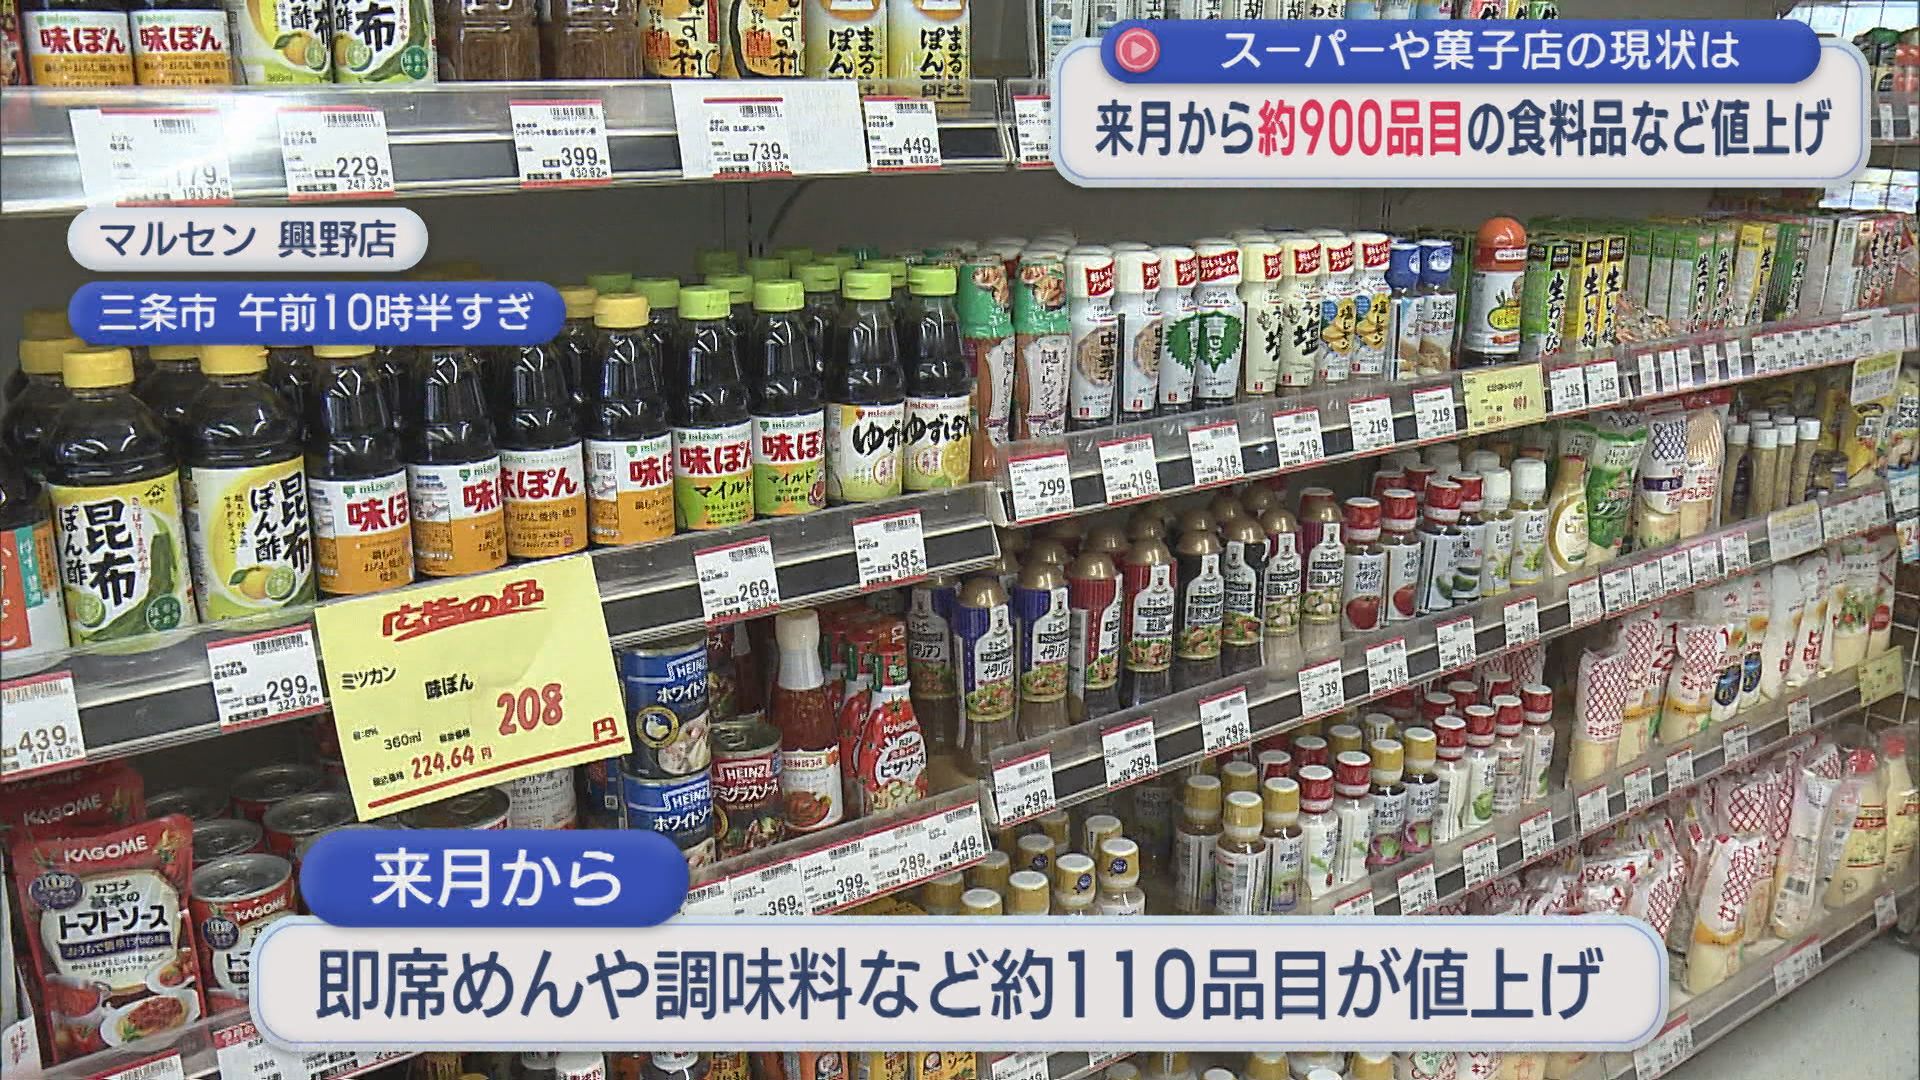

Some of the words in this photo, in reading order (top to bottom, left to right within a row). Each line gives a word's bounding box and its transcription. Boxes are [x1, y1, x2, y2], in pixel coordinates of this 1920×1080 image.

[40, 25, 126, 53] 味ぽん
[139, 25, 222, 52] 味ぽん
[249, 480, 283, 564] ぽん酢
[278, 470, 312, 574] 昆布
[58, 503, 89, 587] ぽん酢
[84, 498, 136, 607] 昆布
[341, 666, 398, 690] ミツカン
[424, 672, 475, 701] 味ぽん
[496, 682, 564, 738] 208
[592, 716, 619, 741] 円
[383, 730, 423, 751] 360ml
[410, 743, 476, 780] 224.64
[480, 744, 493, 761] 円
[725, 764, 767, 782] HEINZ
[23, 794, 102, 826] KAGOME
[63, 834, 149, 864] KAGOME
[58, 904, 169, 940] トマトソース
[235, 894, 288, 922] KAGOME
